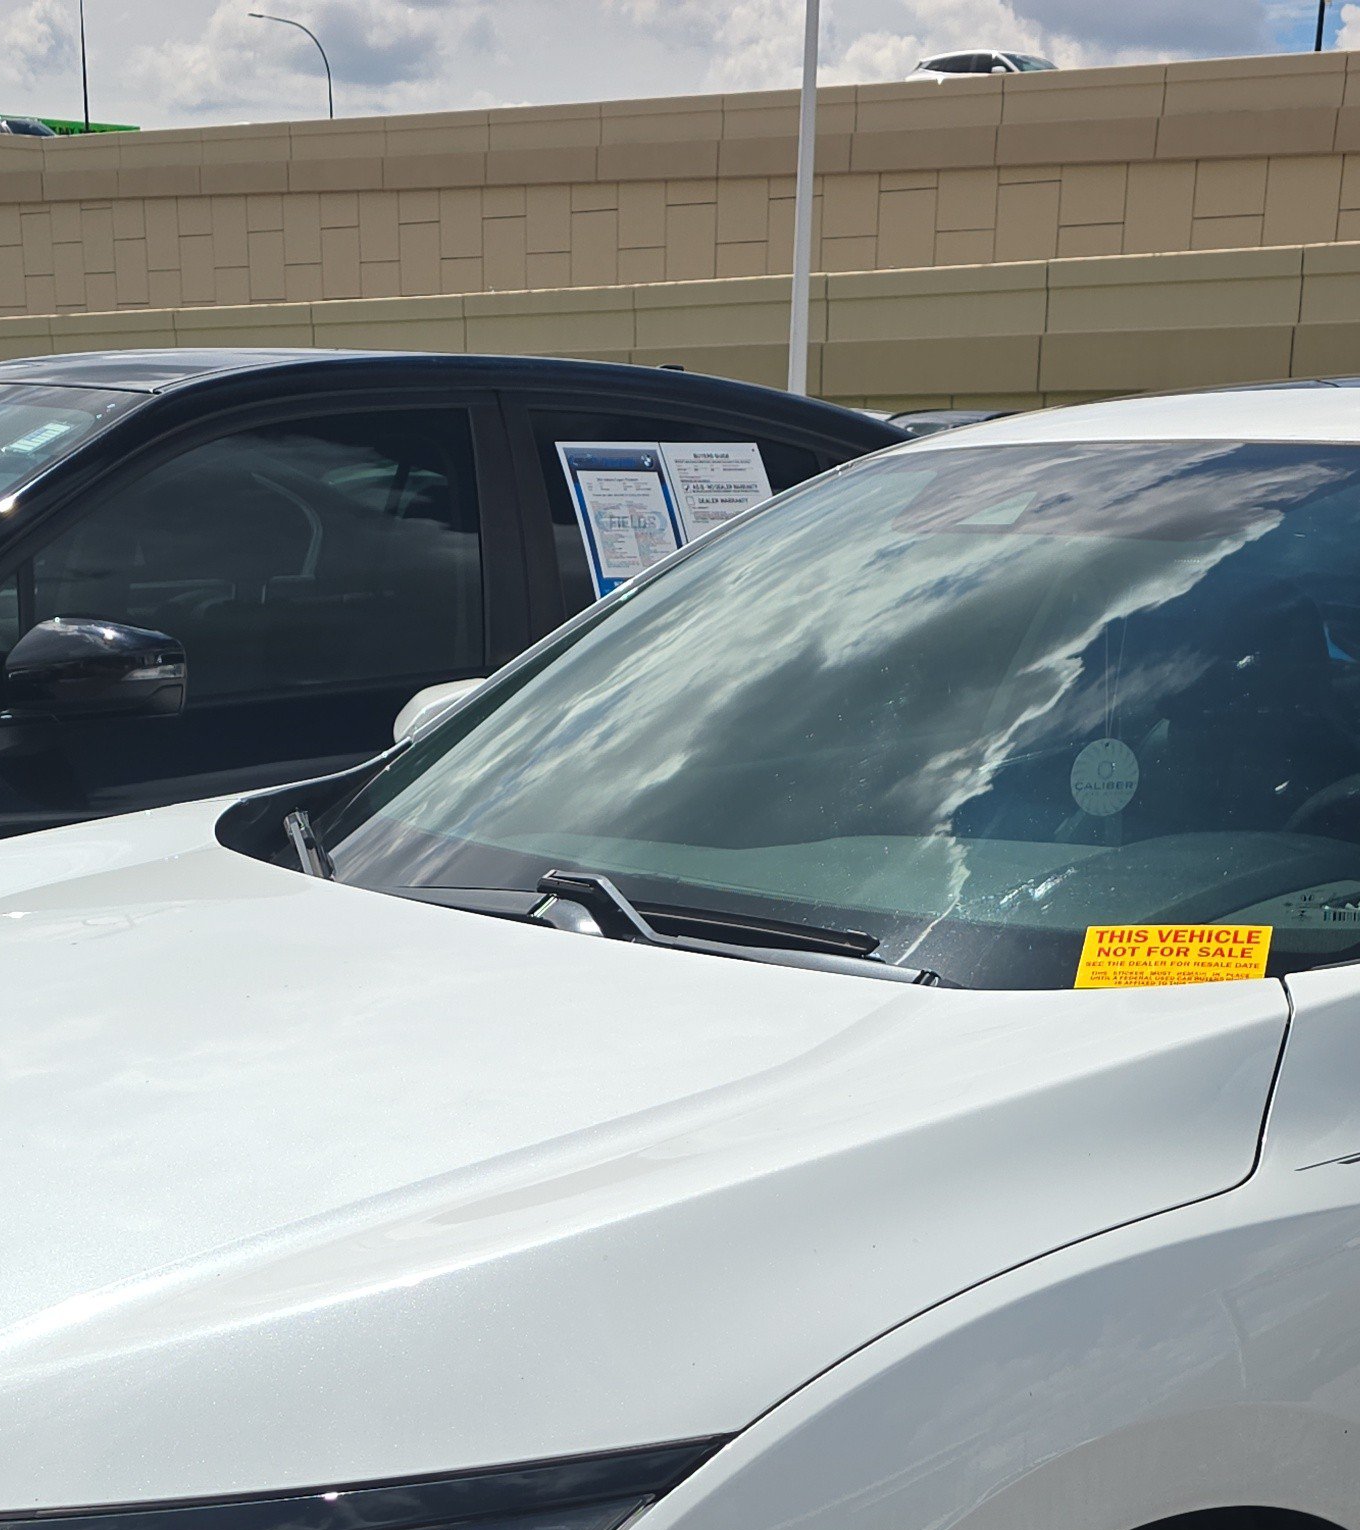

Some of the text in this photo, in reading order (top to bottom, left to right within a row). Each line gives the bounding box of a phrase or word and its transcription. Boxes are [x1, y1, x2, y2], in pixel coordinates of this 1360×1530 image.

[1075, 781, 1134, 791] CALIBER
[1096, 929, 1262, 944] THIS VEHICLE
[1097, 946, 1254, 958] NOT FOR SALE
